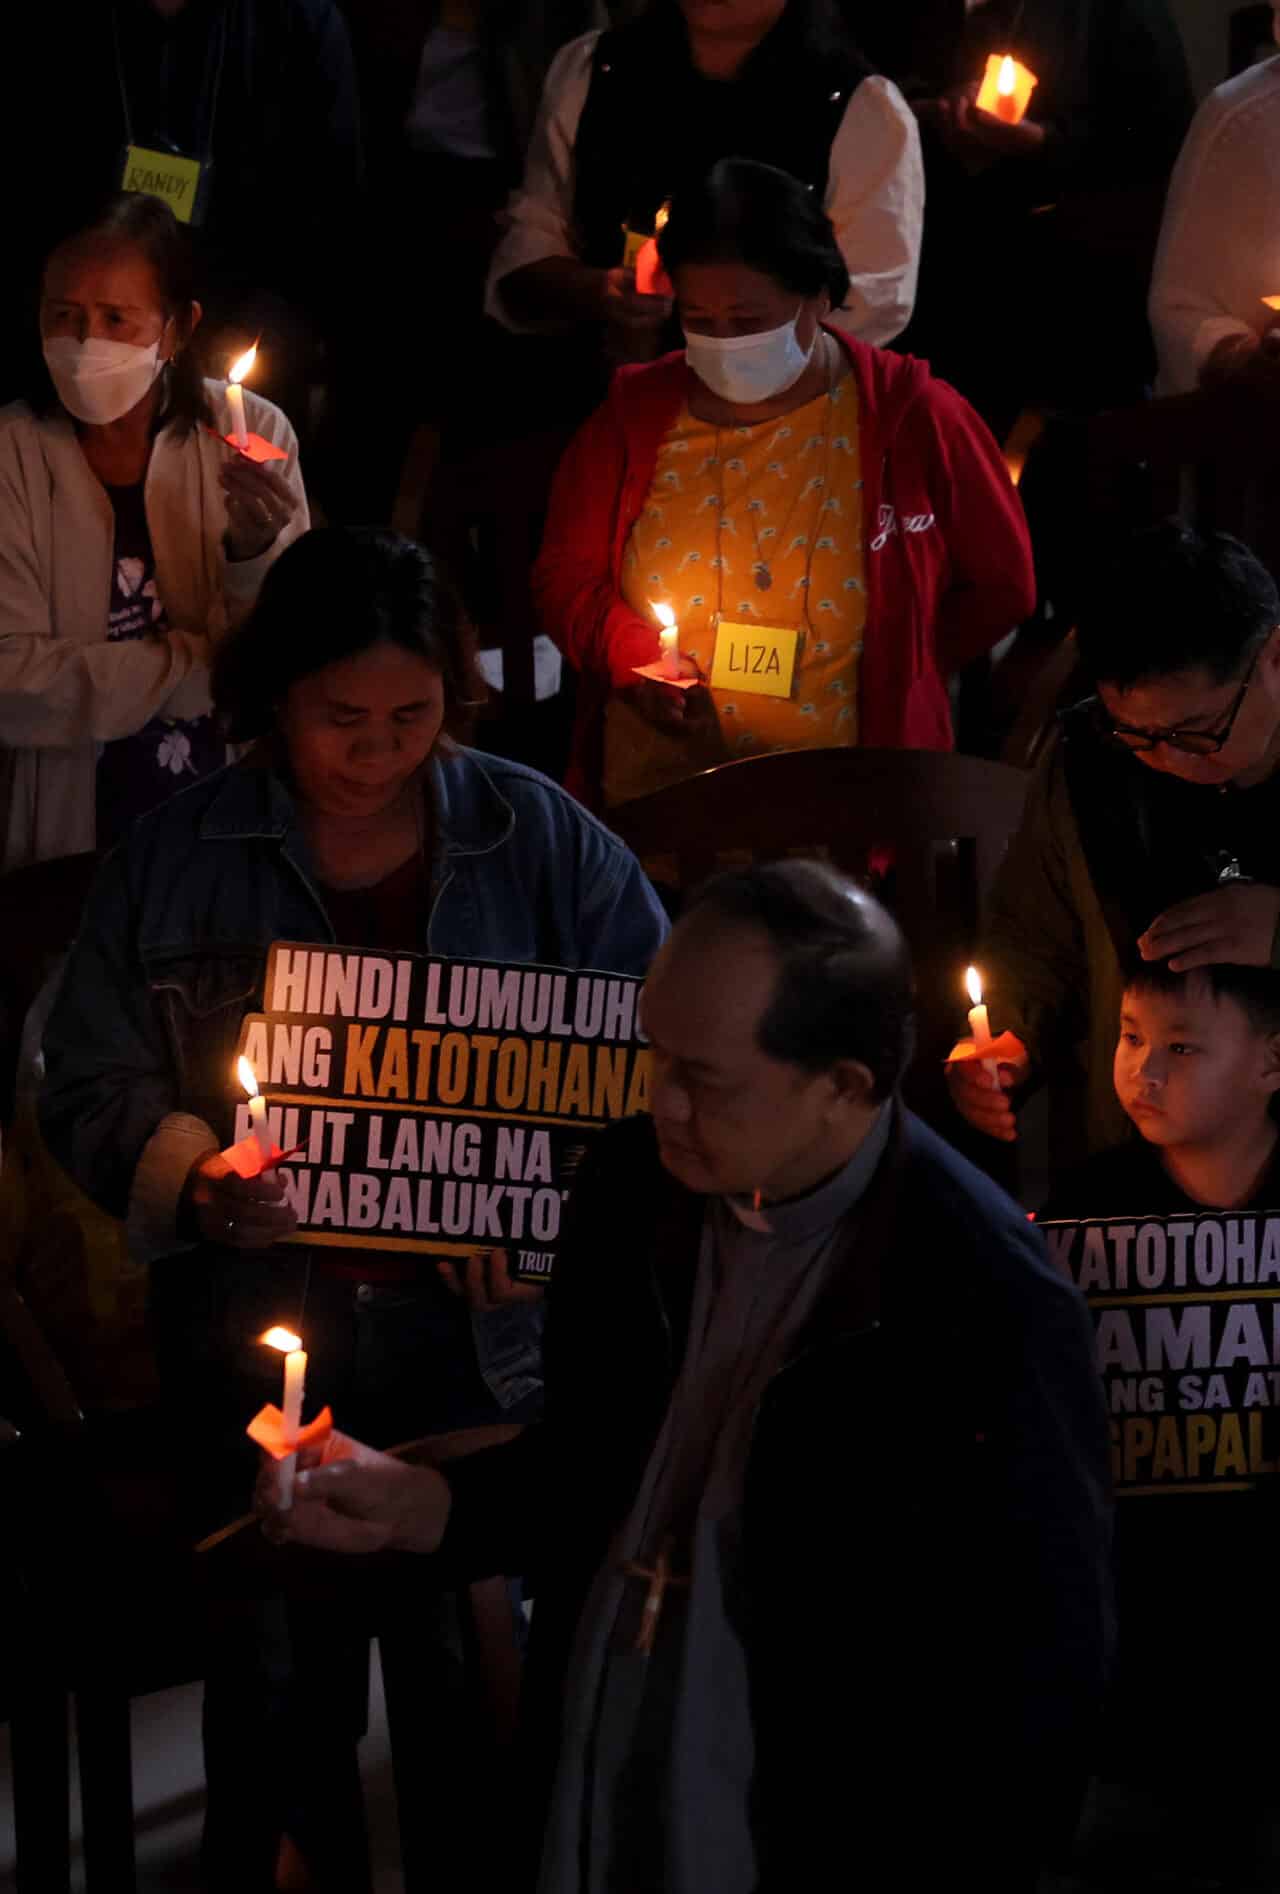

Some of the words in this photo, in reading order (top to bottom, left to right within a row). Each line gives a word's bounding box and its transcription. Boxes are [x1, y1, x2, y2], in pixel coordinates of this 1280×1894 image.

[728, 642, 780, 676] LIZA
[271, 948, 413, 1022] HINDI
[240, 1021, 334, 1088] ANG
[343, 1023, 655, 1119] KATOTOHANA
[366, 1114, 483, 1177] LANG
[494, 1125, 553, 1184] NA
[278, 1167, 569, 1242] NABALUKTO
[1104, 1375, 1166, 1415] NG
[1177, 1374, 1233, 1411] SA
